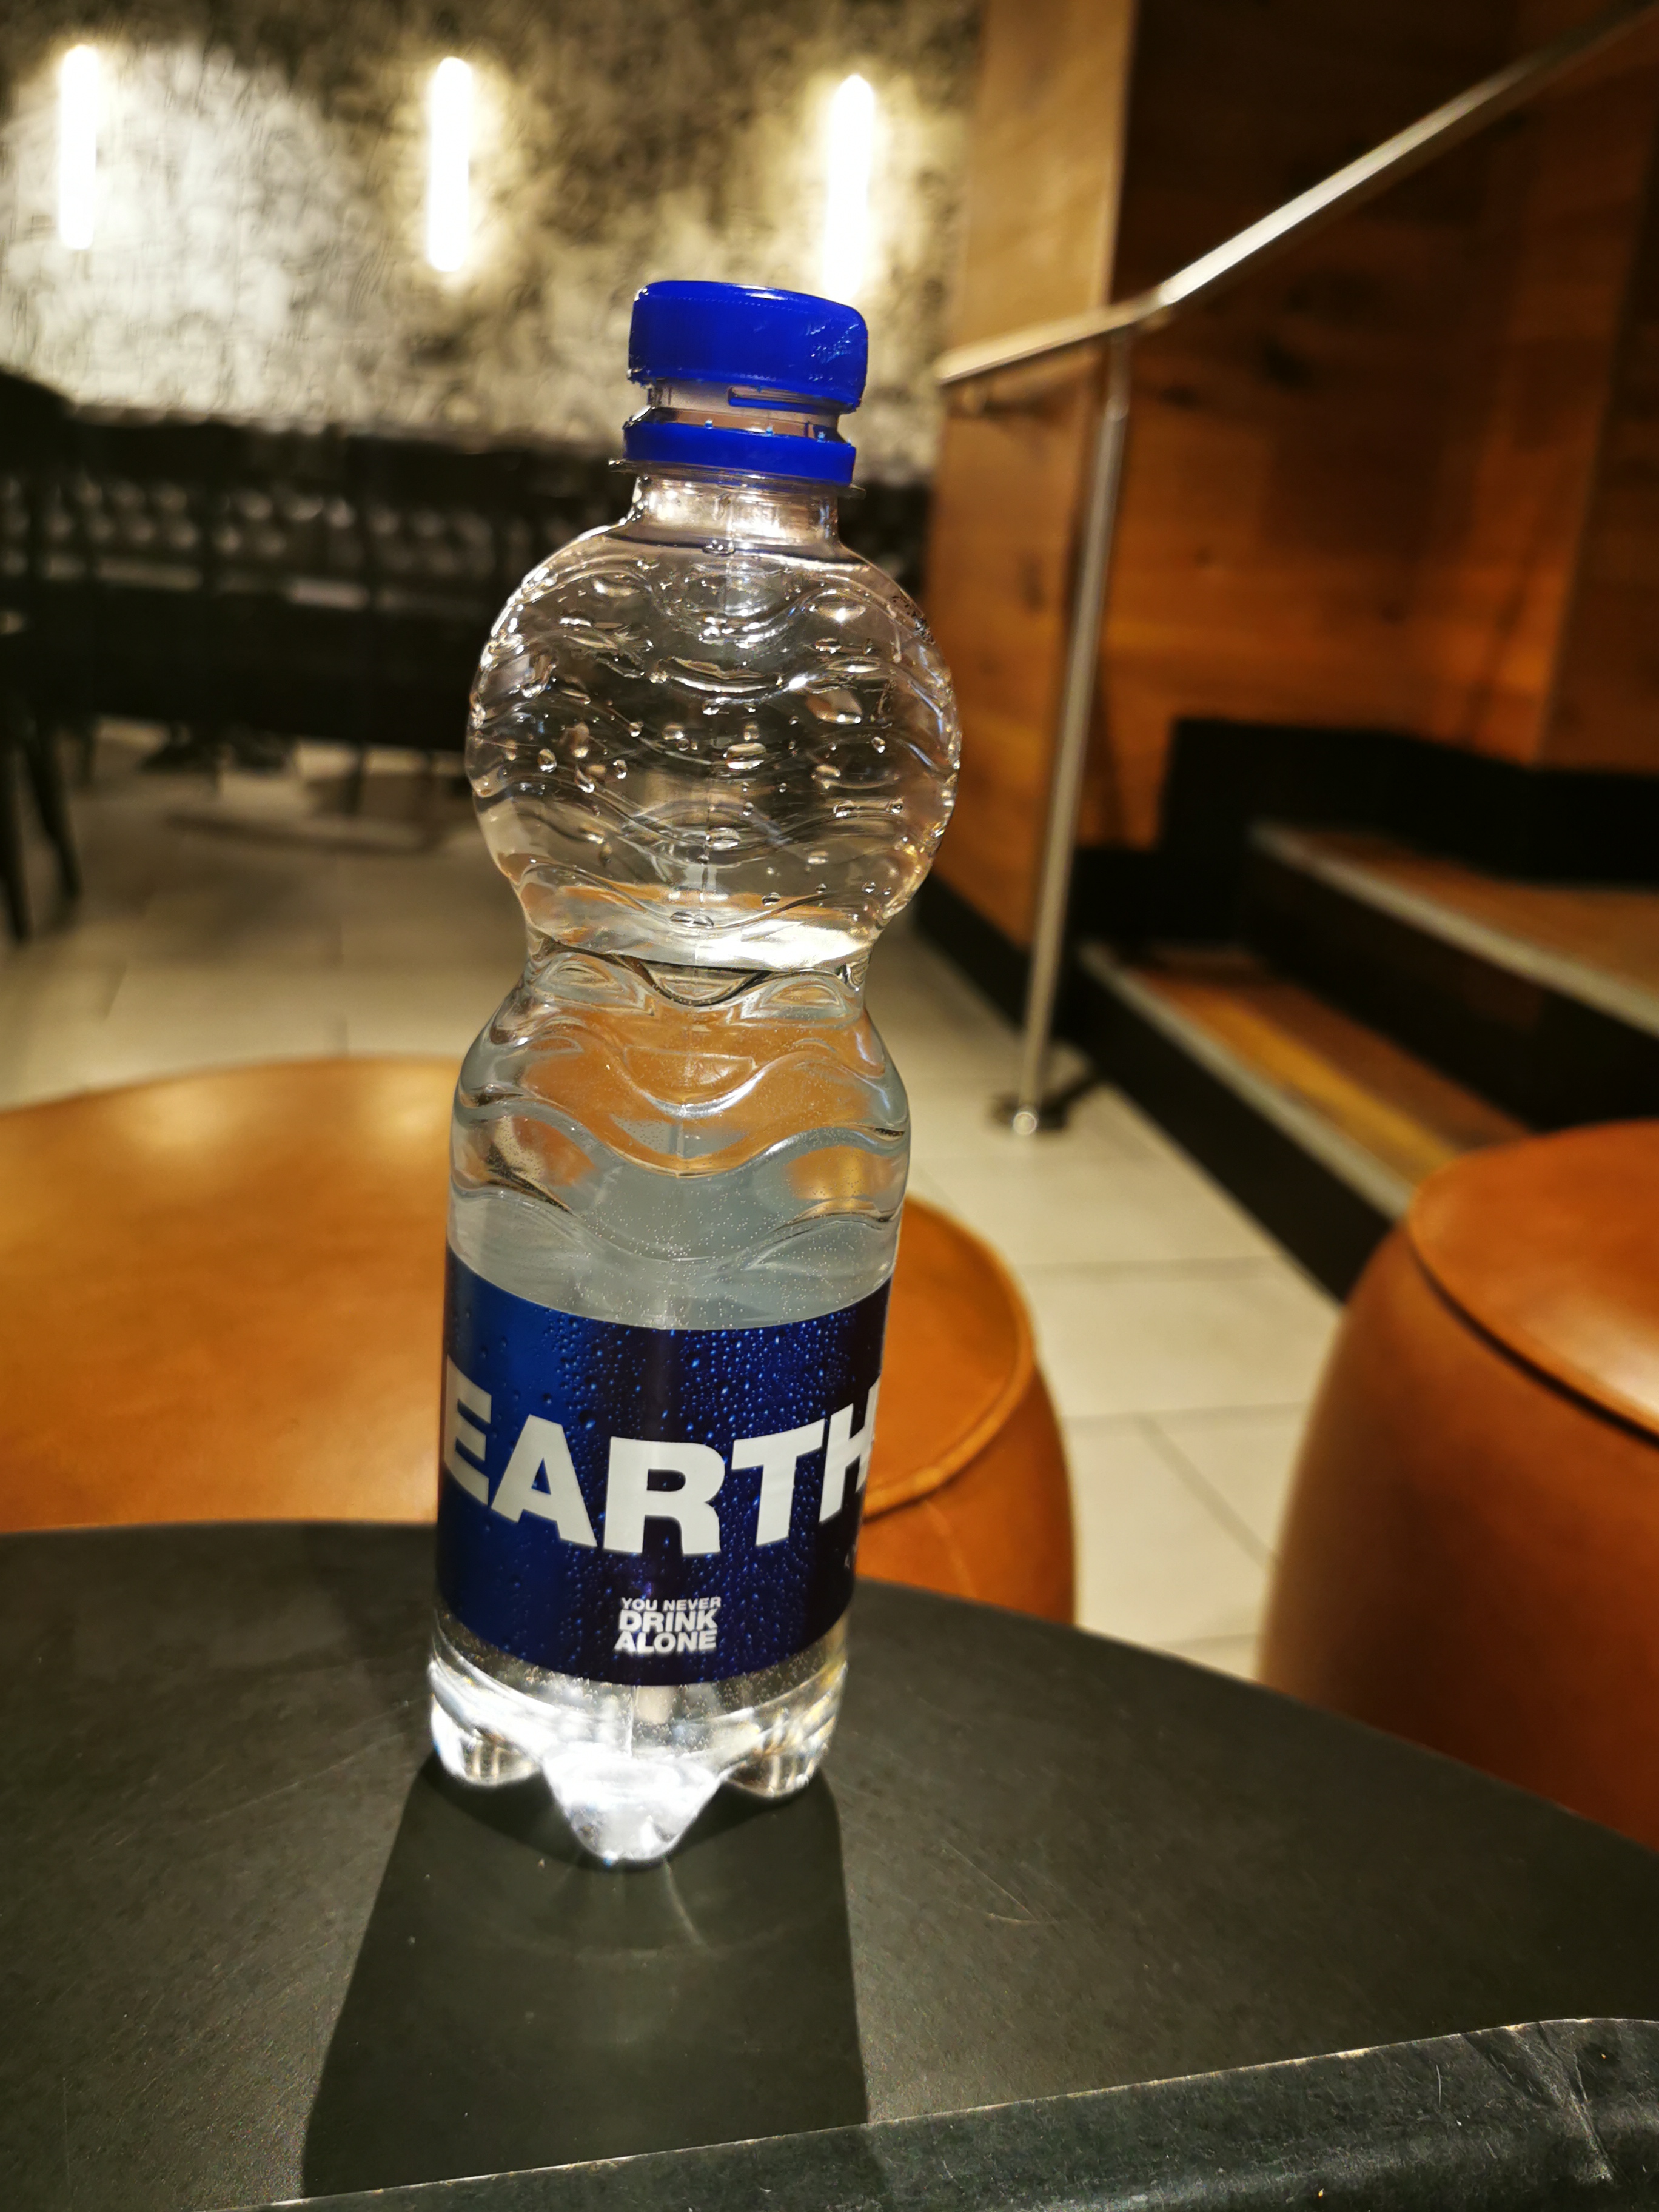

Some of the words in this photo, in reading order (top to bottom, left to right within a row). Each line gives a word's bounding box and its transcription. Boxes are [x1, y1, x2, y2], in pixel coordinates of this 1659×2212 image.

[444, 1355, 881, 1557] EARTH
[621, 1597, 657, 1612] YOU
[663, 1597, 722, 1611] NEVER
[618, 1609, 718, 1632] DRINK
[614, 1629, 717, 1654] ALONE
